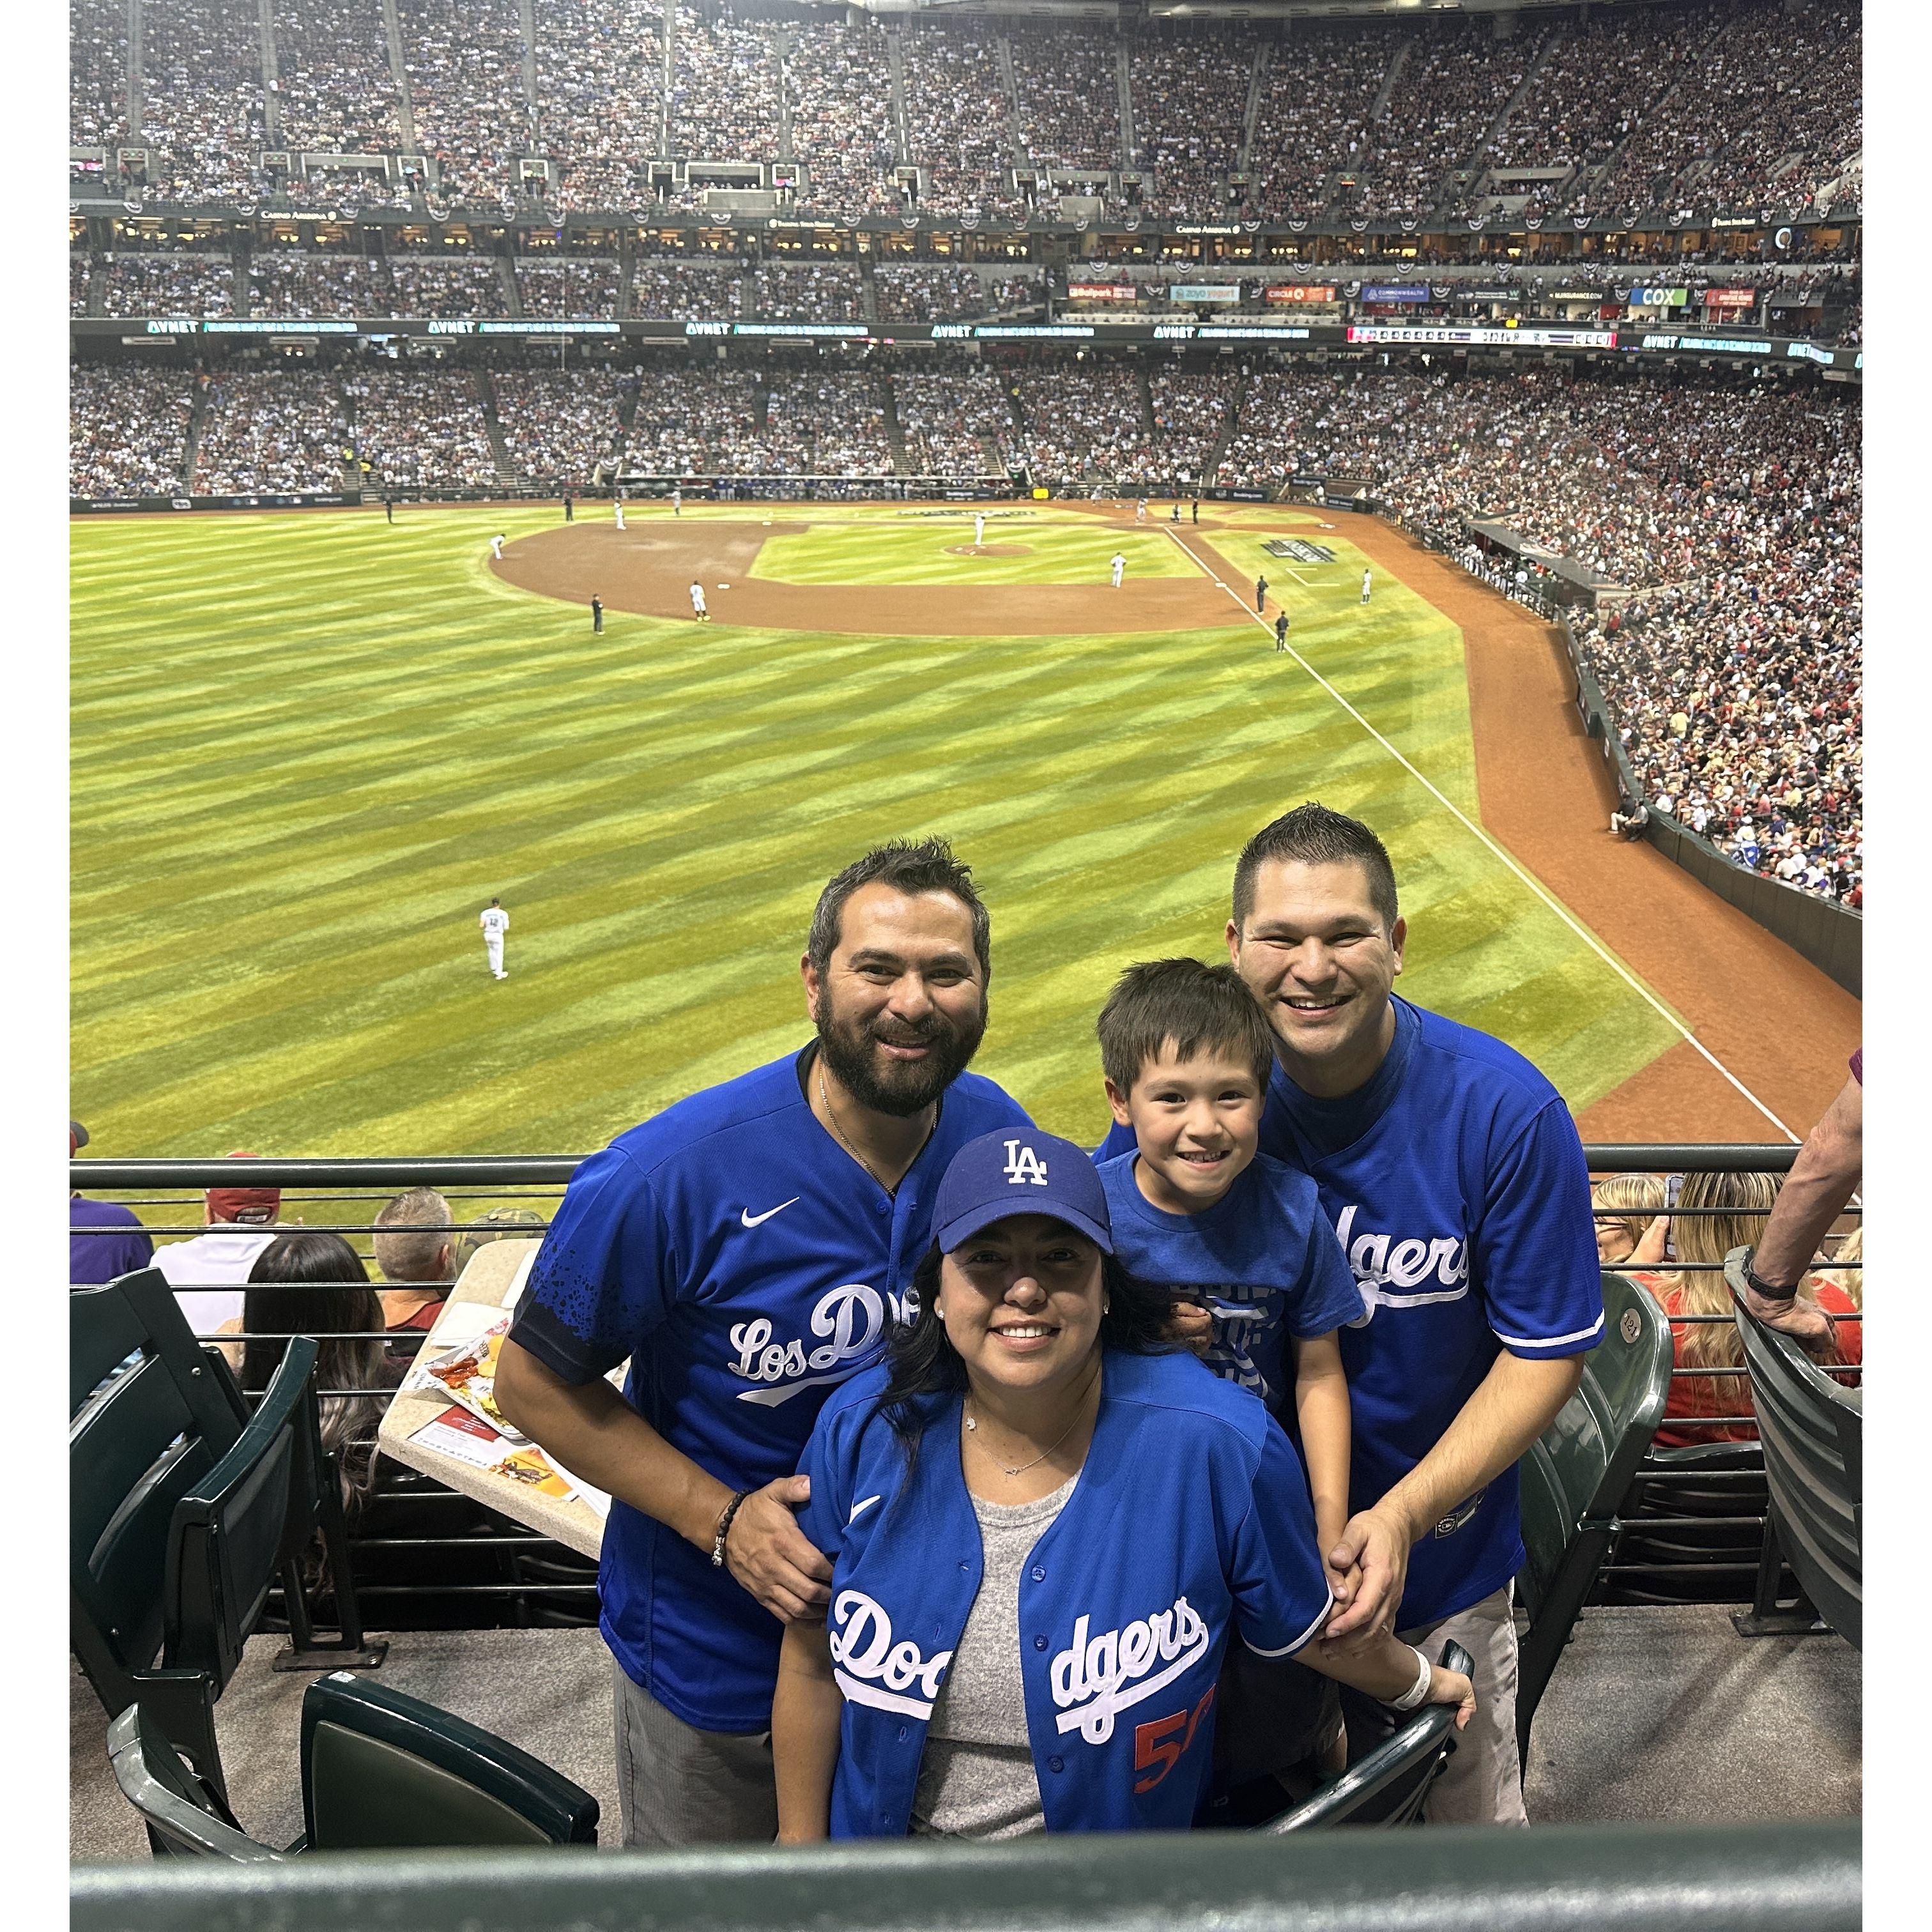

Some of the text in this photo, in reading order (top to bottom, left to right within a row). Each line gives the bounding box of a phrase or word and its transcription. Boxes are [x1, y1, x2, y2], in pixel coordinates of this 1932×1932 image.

[1643, 289, 1675, 305] COX
[147, 321, 199, 333] AVNET
[428, 321, 475, 333] AVNET
[686, 322, 731, 335] AVNET
[931, 325, 972, 337] AVNET
[1153, 326, 1195, 338] AVNET
[1643, 335, 1678, 348] AVNET
[1003, 1139, 1048, 1186] LA
[1623, 1315, 1637, 1337] 121
[727, 1318, 808, 1381] Los
